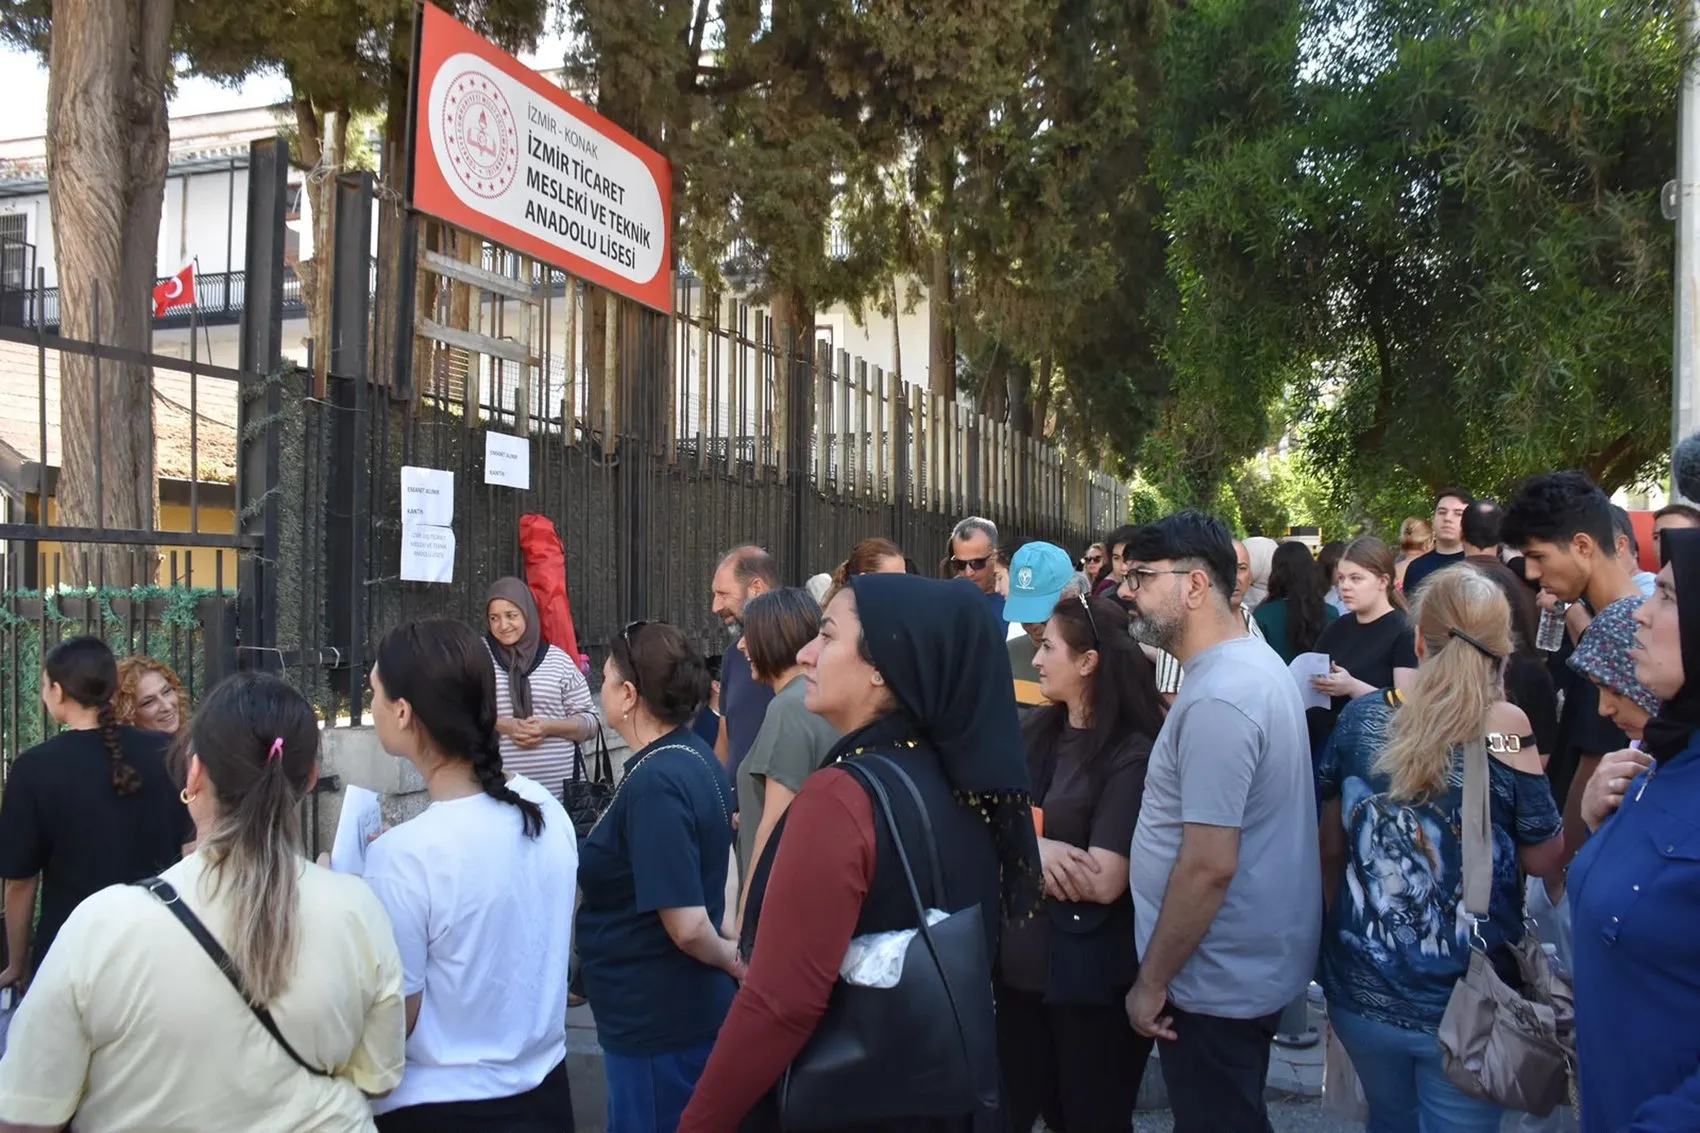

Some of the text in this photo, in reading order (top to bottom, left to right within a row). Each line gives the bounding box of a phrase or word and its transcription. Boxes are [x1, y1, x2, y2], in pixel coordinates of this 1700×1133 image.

[528, 101, 556, 135] İZMİR
[565, 127, 598, 160] KONAK
[528, 129, 569, 176] İZMİR
[572, 159, 625, 205] TİCARET
[525, 199, 636, 270] ANADOLU LİSESİ
[527, 166, 651, 250] MESLEKİ VE TEKNİK
